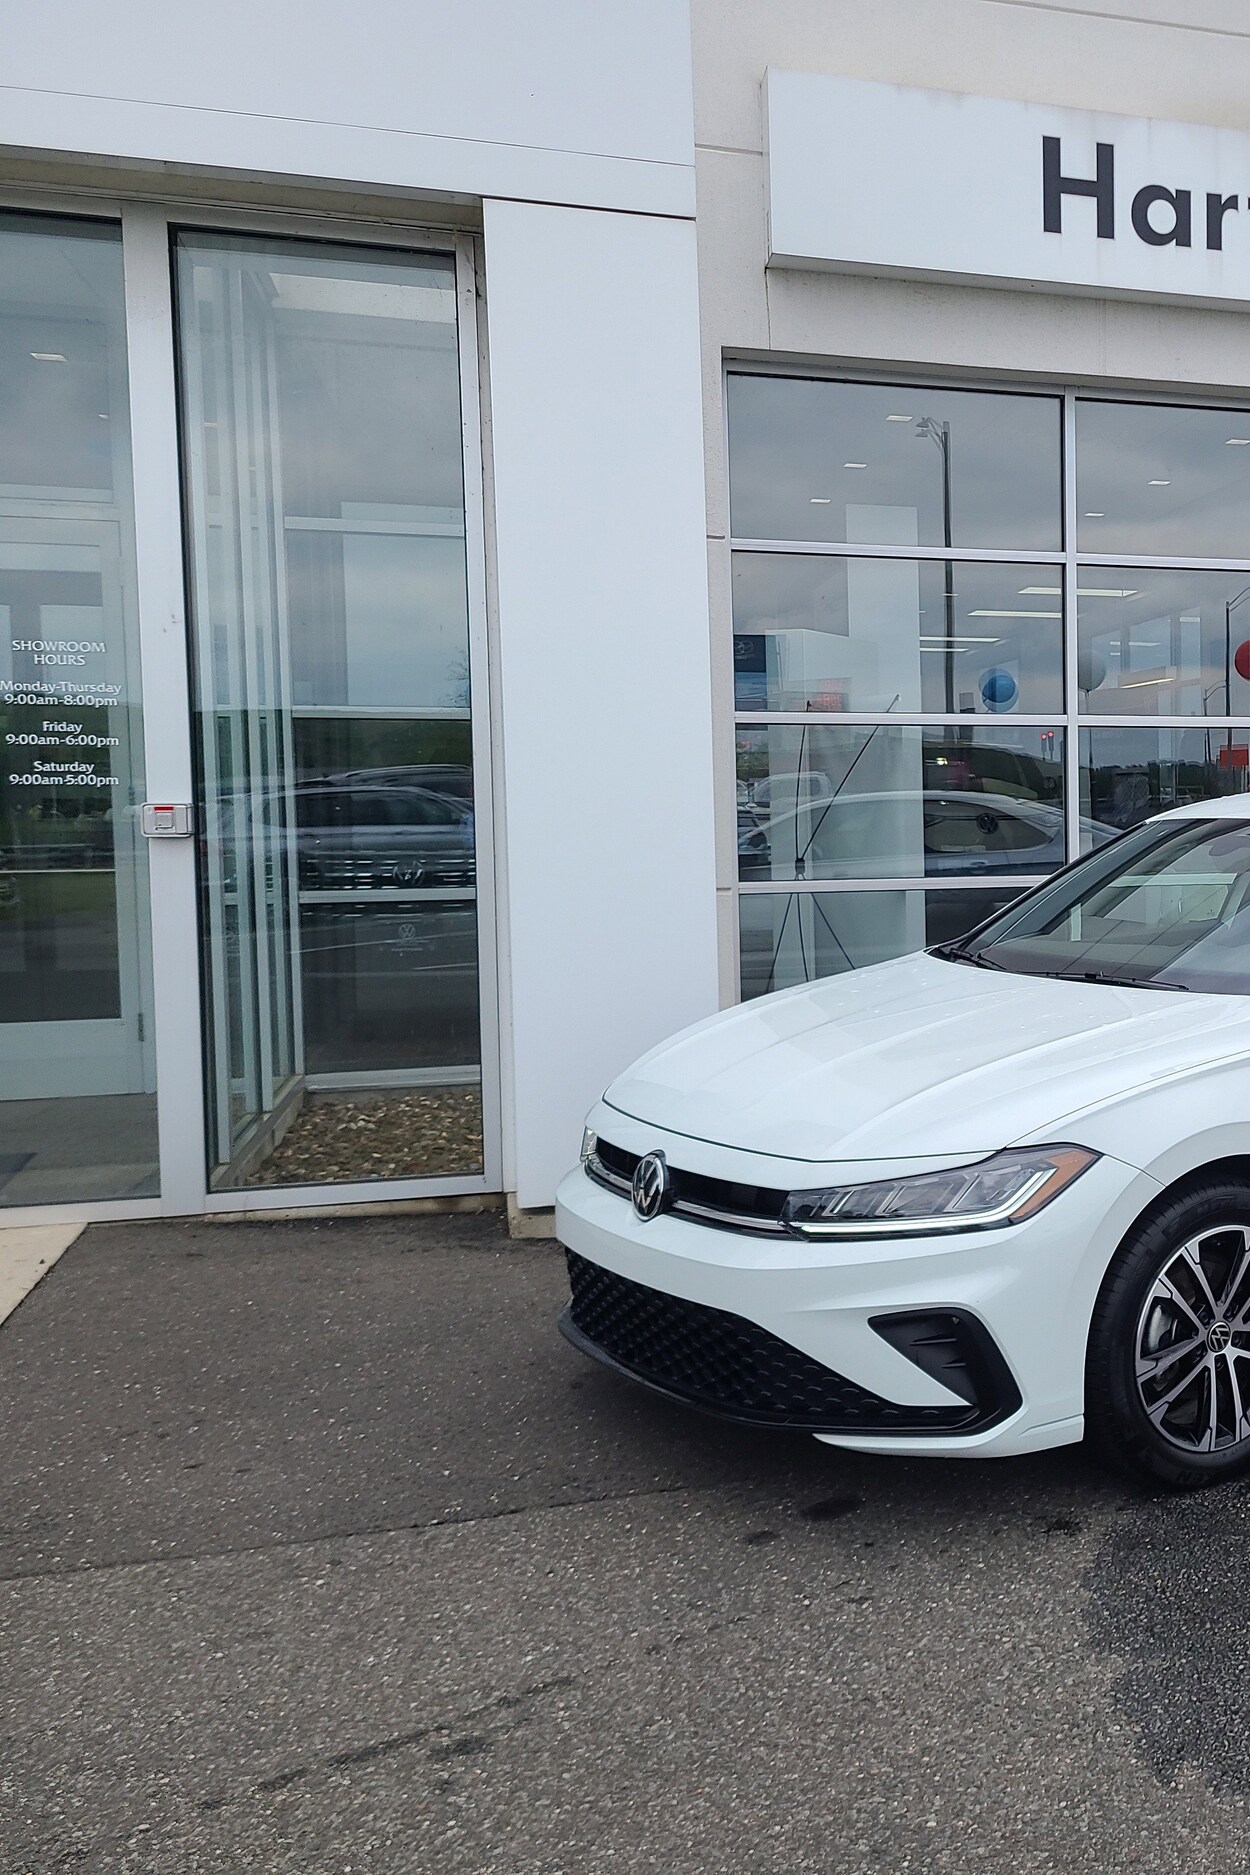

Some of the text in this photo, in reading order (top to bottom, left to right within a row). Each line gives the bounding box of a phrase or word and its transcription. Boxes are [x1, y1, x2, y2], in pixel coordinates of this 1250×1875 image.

[11, 640, 106, 653] SHOWROOM
[34, 654, 86, 666] HOURS
[0, 680, 122, 695] Monday-Thursday
[4, 693, 118, 708] 9:00am-8:00pm
[42, 720, 83, 734] Friday
[5, 733, 119, 748] 9:00am-6:00pm
[33, 760, 95, 774] Saturday
[8, 773, 119, 788] 9:00am-5:00pm
